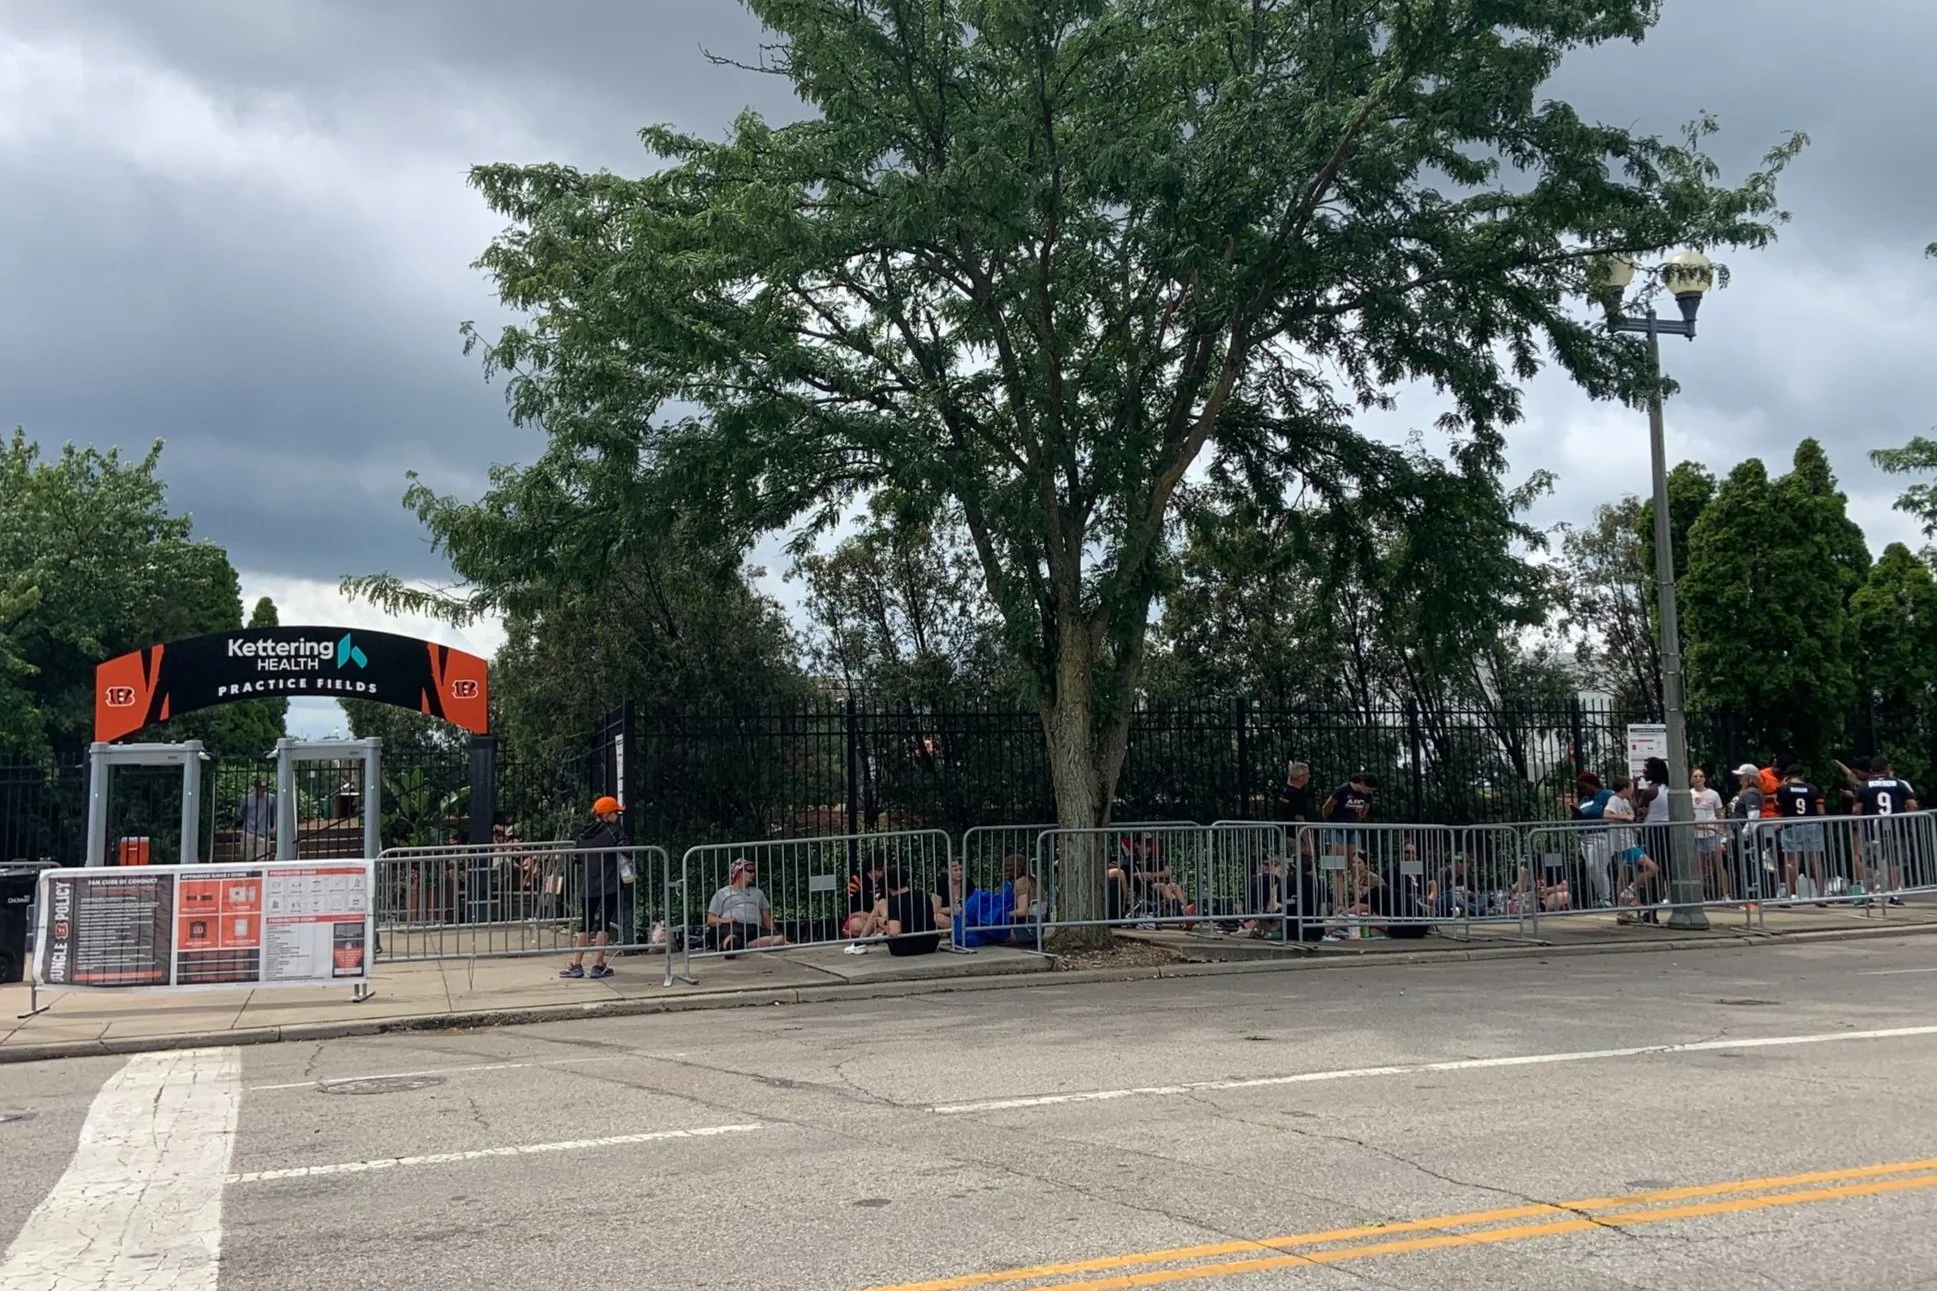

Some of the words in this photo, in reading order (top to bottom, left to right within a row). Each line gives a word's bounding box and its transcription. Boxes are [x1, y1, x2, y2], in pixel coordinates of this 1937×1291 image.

[228, 638, 334, 660] Kettering
[257, 658, 319, 671] HEALTH
[218, 678, 307, 697] PRACTICE
[317, 678, 377, 694] FIELDS
[1795, 798, 1806, 815] 9
[1877, 791, 1893, 816] 9
[55, 881, 71, 921] POLICY
[49, 942, 68, 983] JUNGLE
